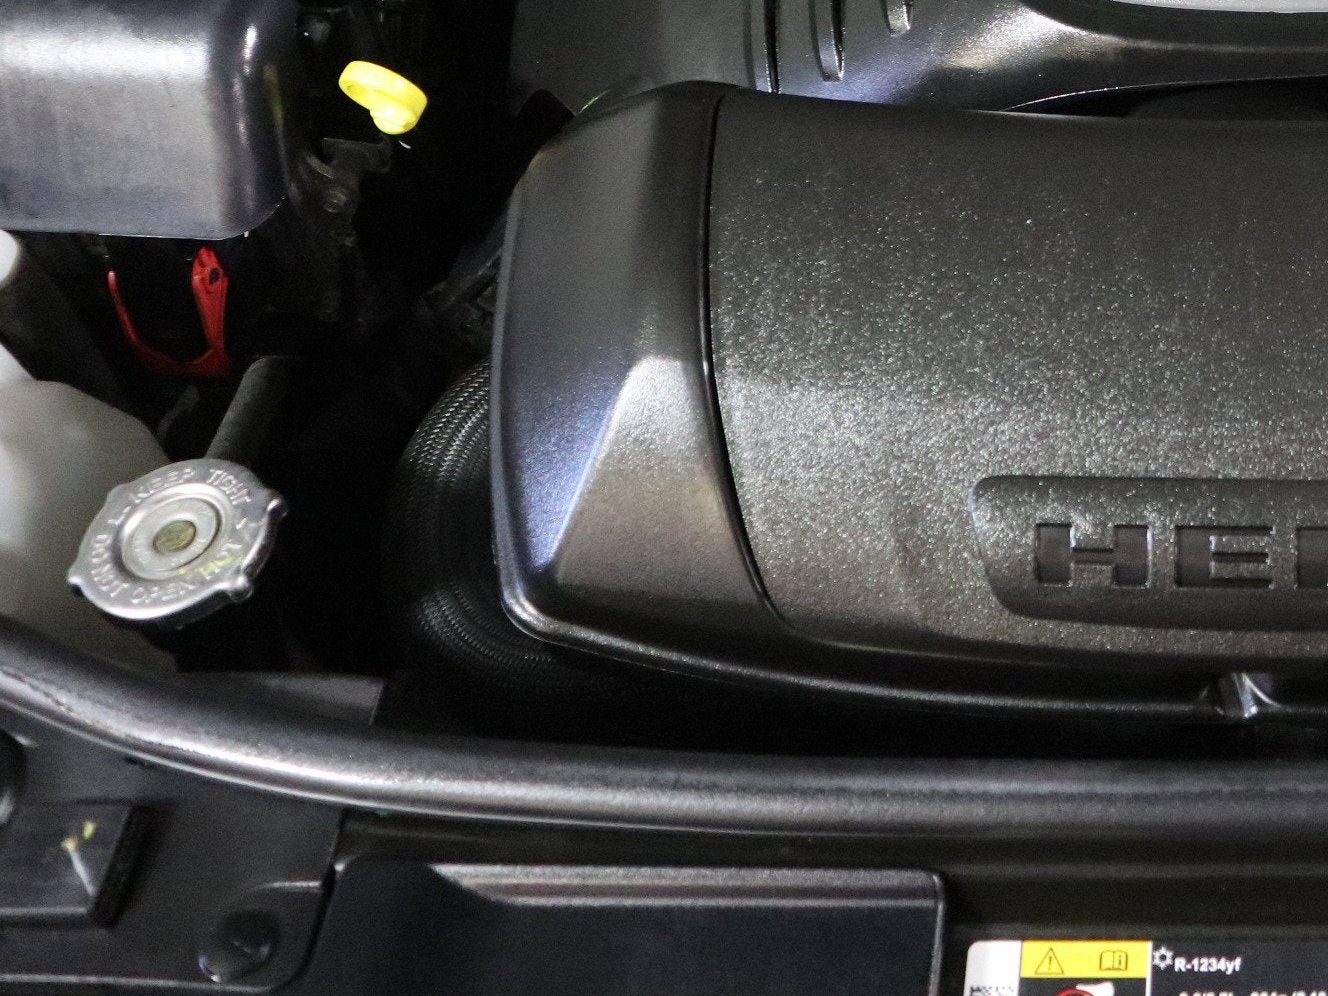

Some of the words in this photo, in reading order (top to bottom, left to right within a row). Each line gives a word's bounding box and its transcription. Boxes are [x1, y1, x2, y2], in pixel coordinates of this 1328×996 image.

[130, 468, 195, 503] KEEP
[206, 468, 251, 505] TIGHT
[1174, 956, 1241, 975] R-1234yf
